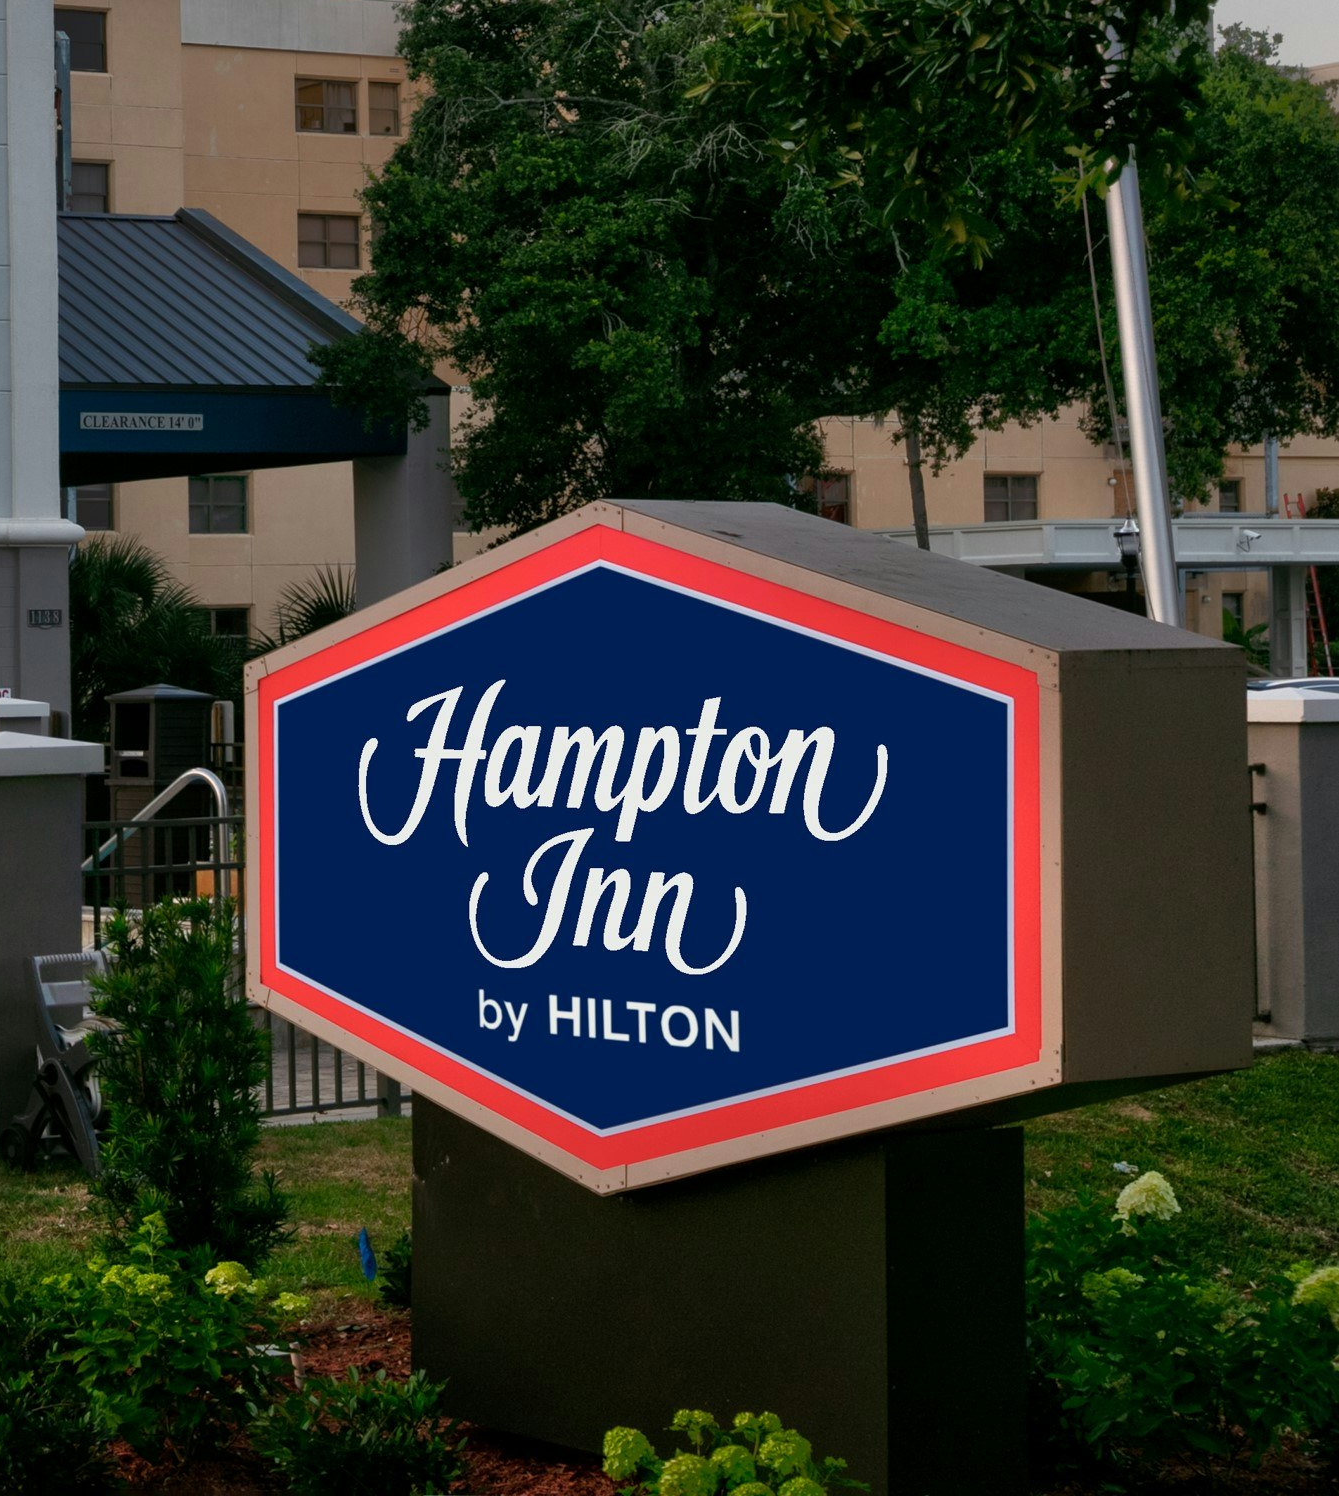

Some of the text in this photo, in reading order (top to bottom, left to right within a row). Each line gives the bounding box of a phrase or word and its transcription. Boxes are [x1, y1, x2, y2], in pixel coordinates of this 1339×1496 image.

[83, 414, 164, 429] CLEARANCE
[169, 416, 184, 429] 14'
[30, 610, 60, 625] 1138
[358, 679, 888, 848] Hampton
[469, 827, 747, 975] Inn
[478, 988, 741, 1053] by HILTON
